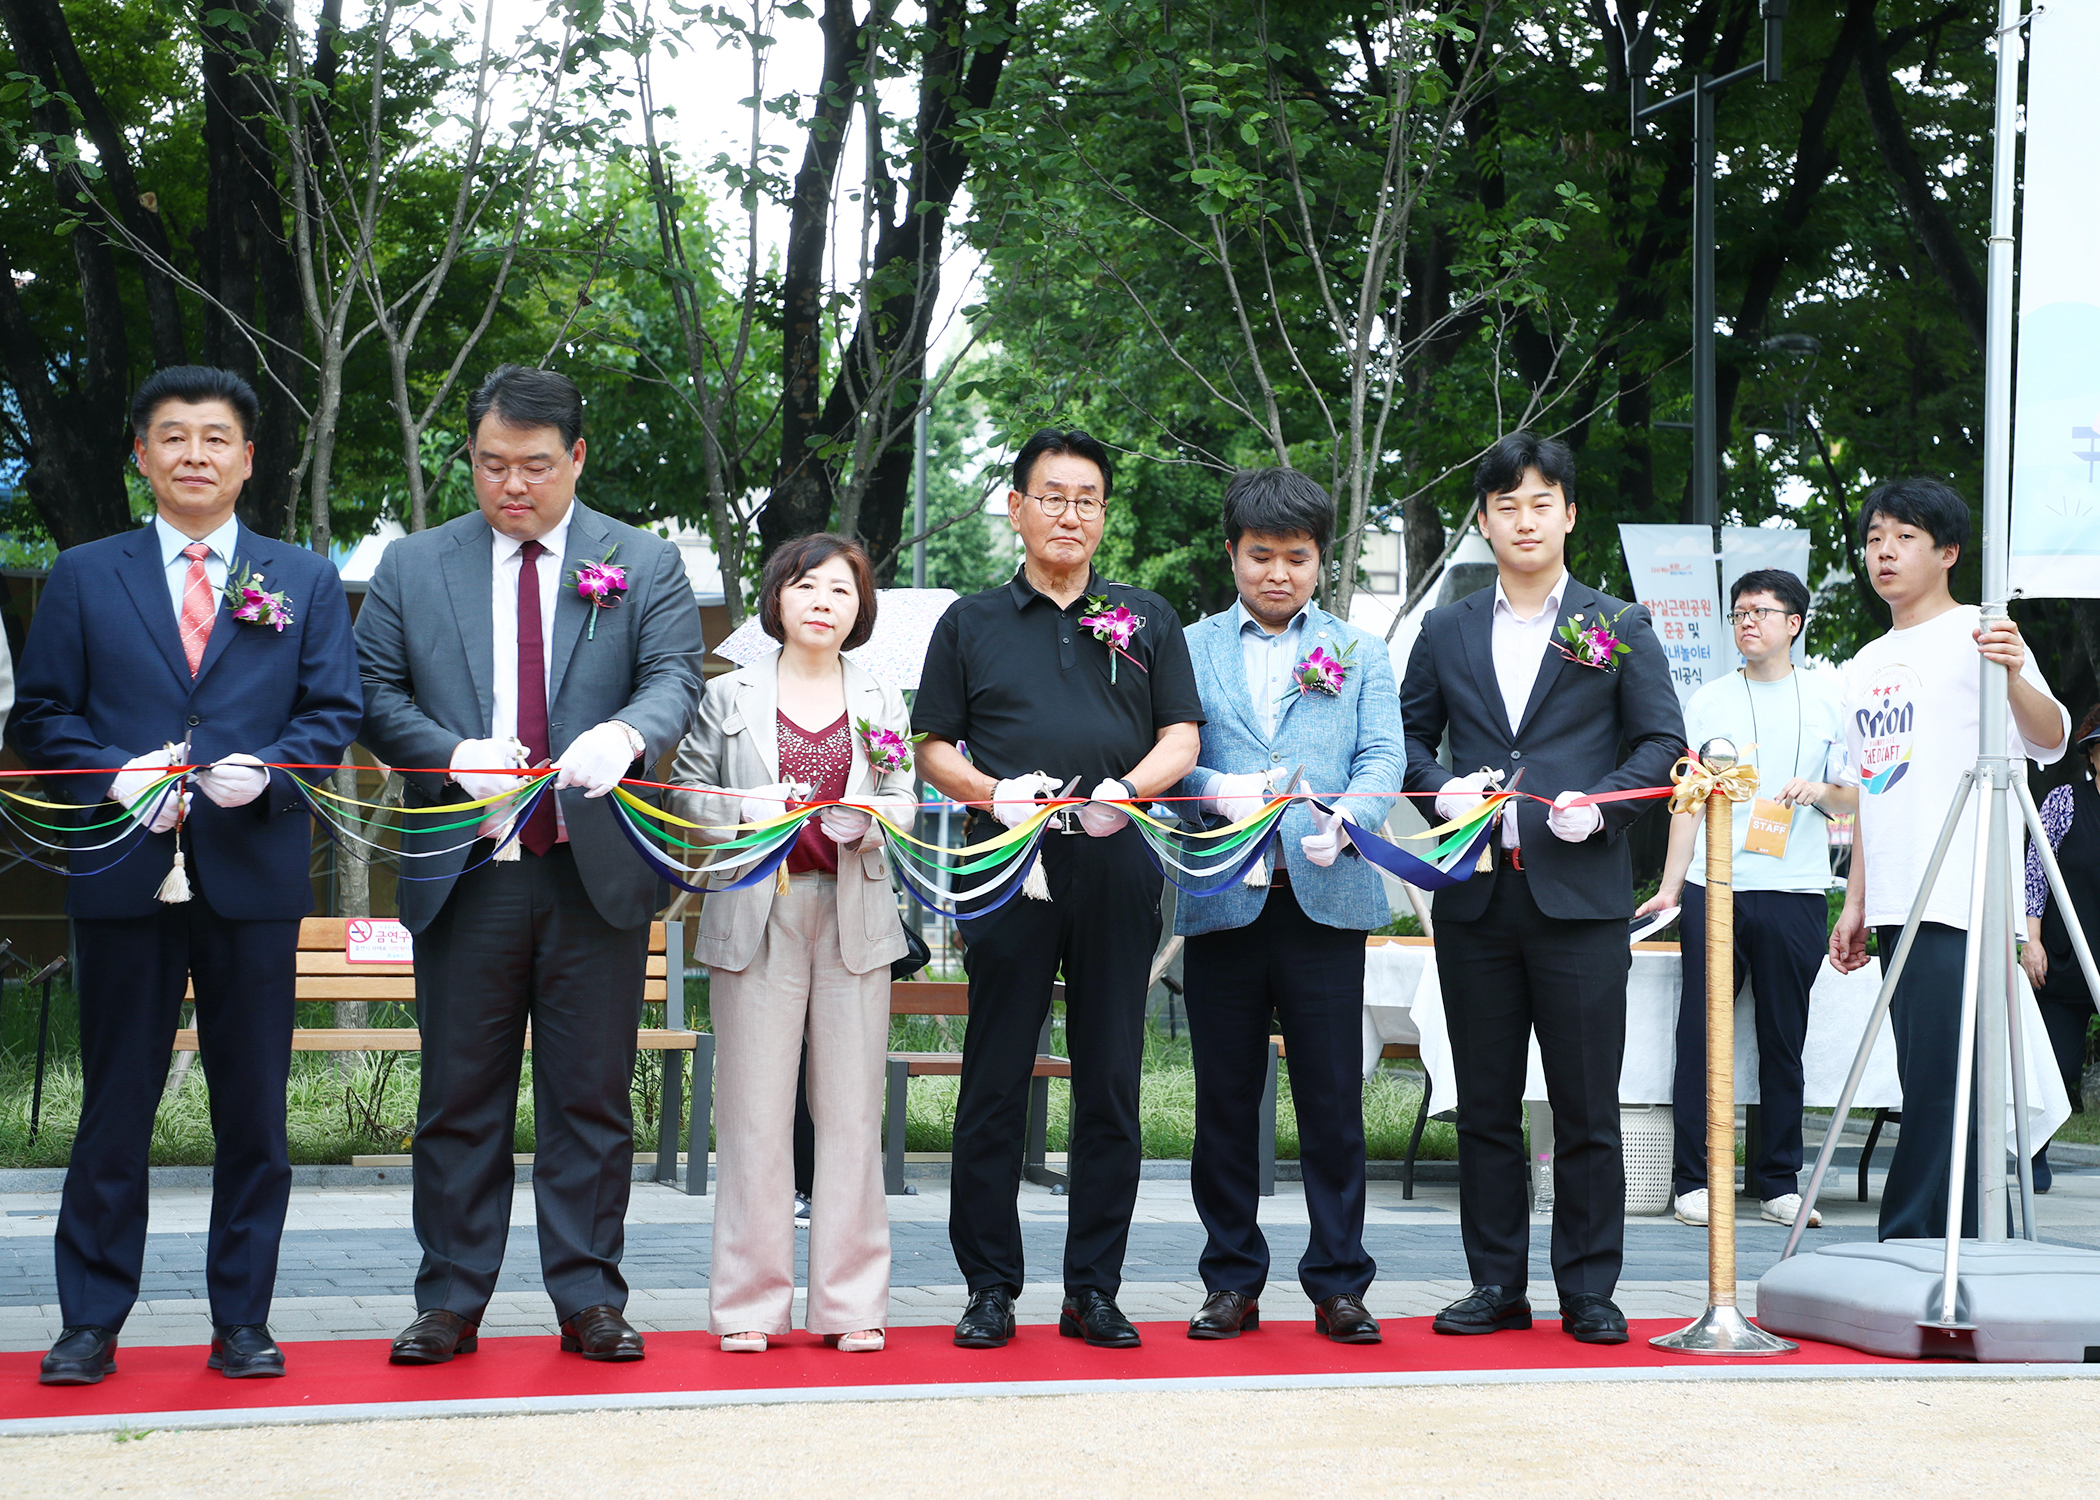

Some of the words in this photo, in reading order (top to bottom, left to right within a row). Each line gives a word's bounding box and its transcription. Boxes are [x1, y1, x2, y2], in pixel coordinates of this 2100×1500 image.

[1641, 599, 1711, 617] 잠실근린공원
[1664, 622, 1684, 640] 준공
[1688, 622, 1700, 639] 및
[1671, 667, 1702, 684] 기공식
[1752, 820, 1786, 835] STAFF
